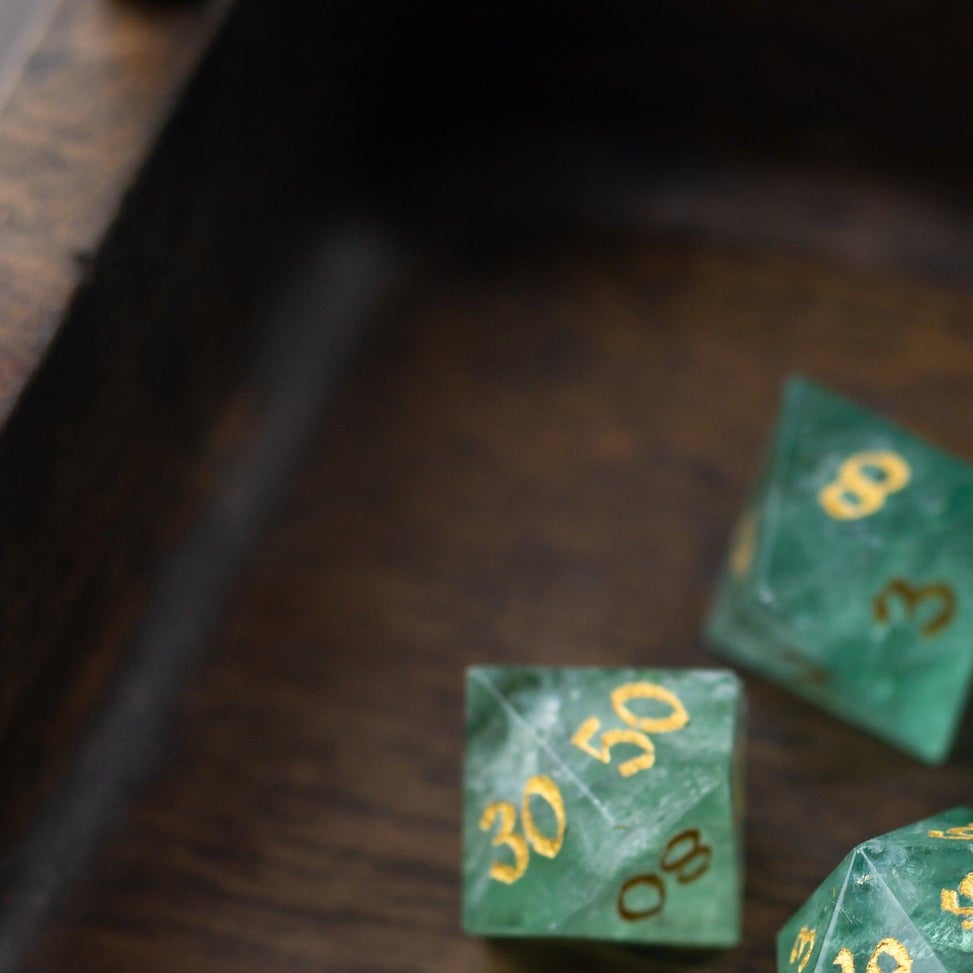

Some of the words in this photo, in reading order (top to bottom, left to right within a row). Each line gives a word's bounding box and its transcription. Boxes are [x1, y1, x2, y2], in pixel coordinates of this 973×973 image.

[819, 451, 912, 520] 8
[872, 577, 957, 638] 3
[571, 682, 690, 777] 50
[479, 775, 566, 883] 30
